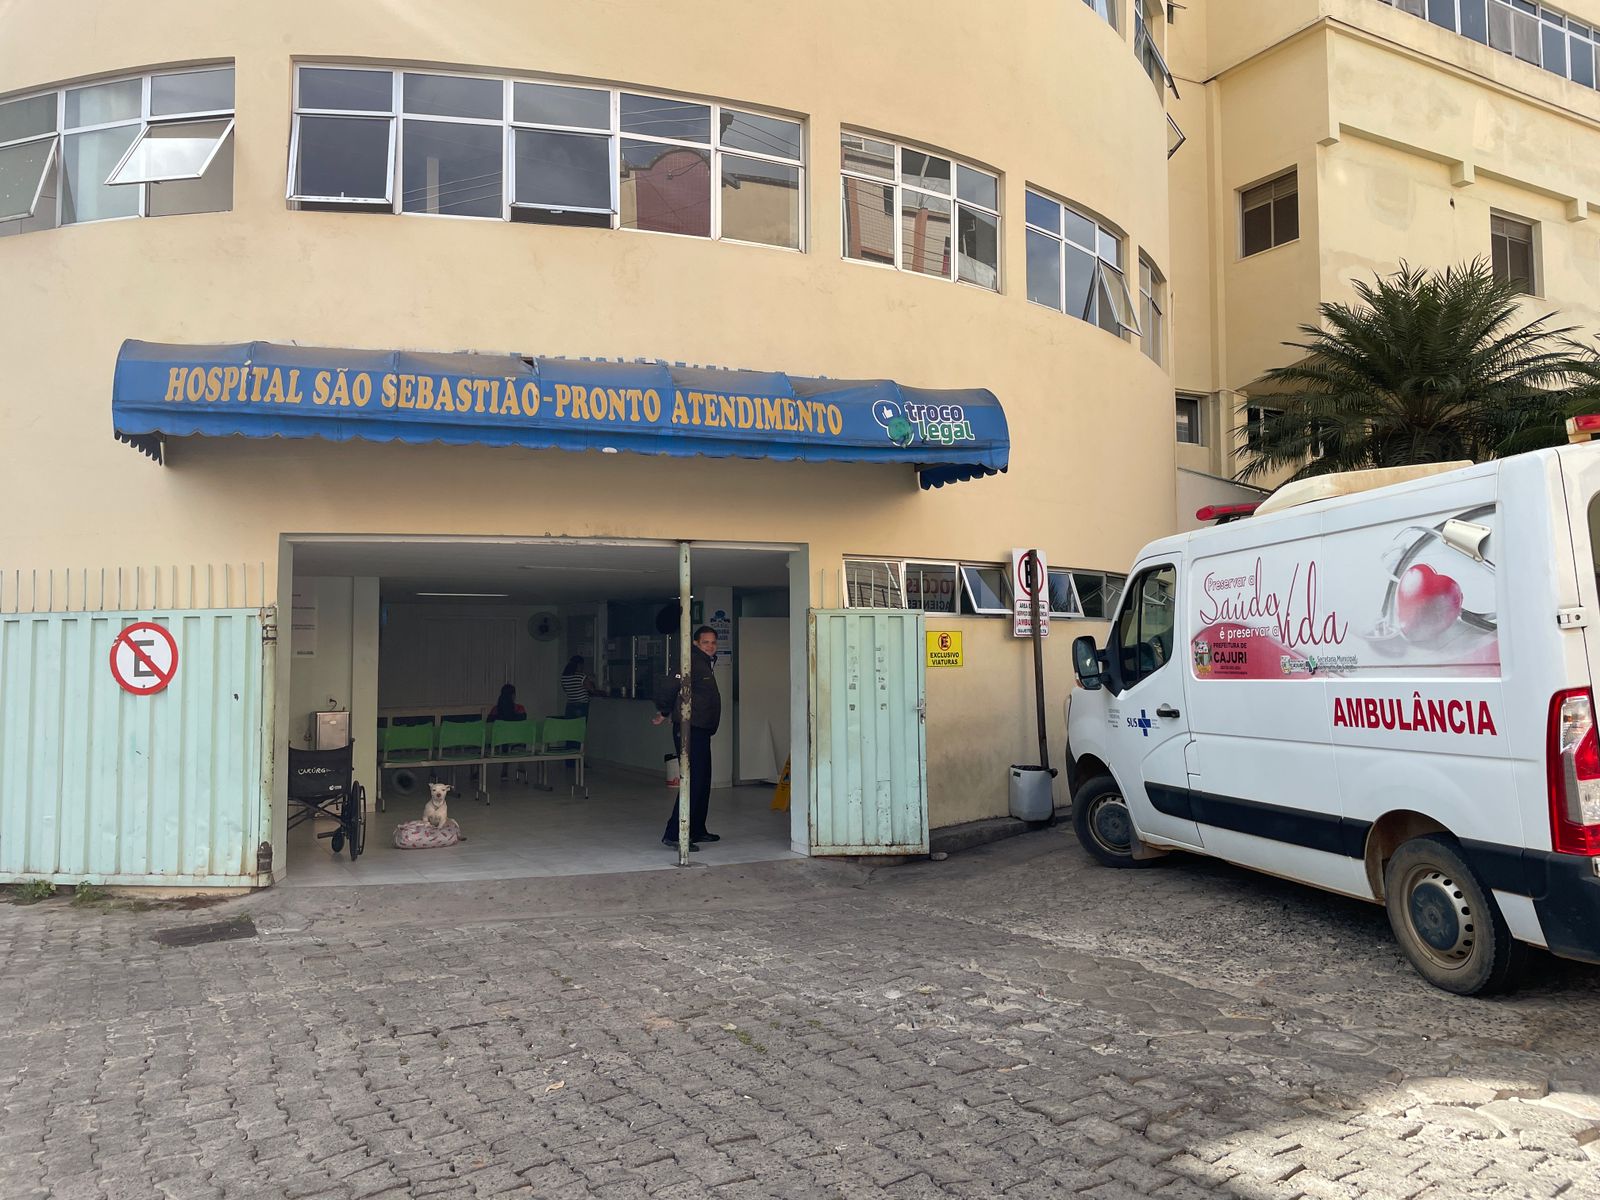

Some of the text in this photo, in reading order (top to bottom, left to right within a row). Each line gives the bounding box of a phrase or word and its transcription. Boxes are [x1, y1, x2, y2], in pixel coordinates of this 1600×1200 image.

[312, 368, 372, 407] SÃO
[671, 392, 843, 436] ATENDIMENTO
[904, 401, 964, 423] troco
[918, 421, 975, 445] legal
[1199, 556, 1280, 625] Saúde
[1207, 575, 1247, 592] Preservar
[1272, 561, 1349, 648] Vida
[1219, 627, 1226, 639] é
[1227, 626, 1269, 642] preservar
[929, 651, 960, 659] EXCLUSIVO
[1213, 651, 1248, 664] CAJURI
[1126, 717, 1138, 727] SUS
[1333, 691, 1497, 736] AMBULÂNCIA
